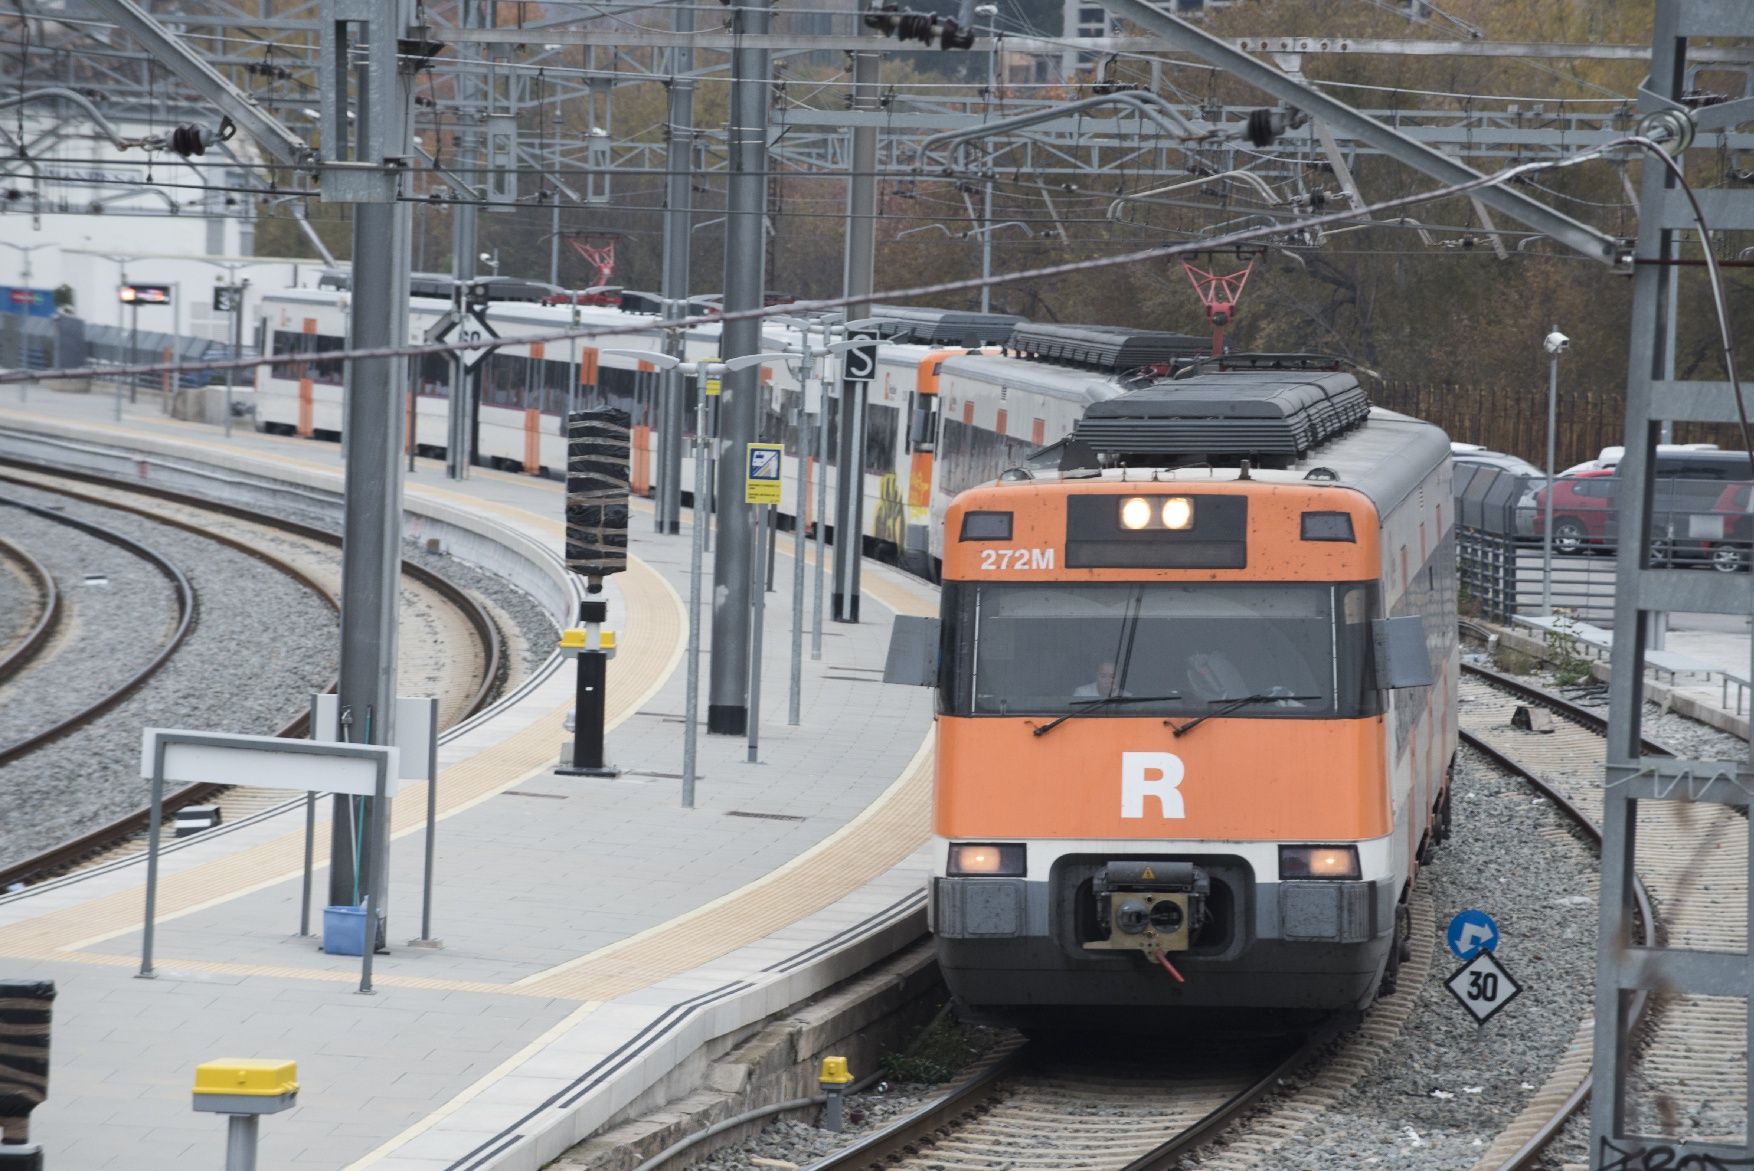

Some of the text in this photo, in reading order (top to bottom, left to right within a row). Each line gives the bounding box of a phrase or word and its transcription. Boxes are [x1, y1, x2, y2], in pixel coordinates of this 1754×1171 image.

[850, 334, 873, 377] S
[980, 548, 1055, 570] 272M
[1121, 751, 1185, 818] R
[1467, 971, 1498, 1002] 30
